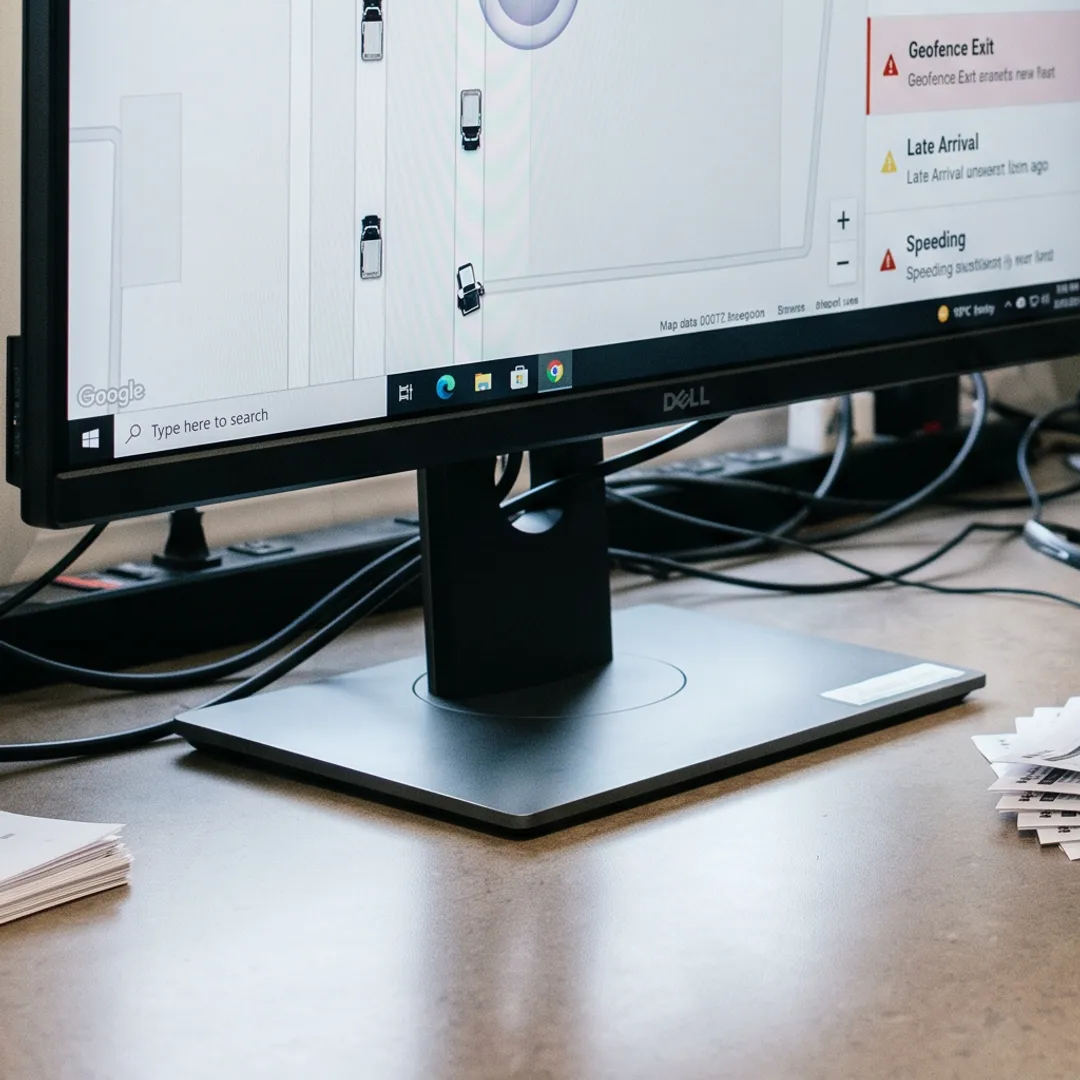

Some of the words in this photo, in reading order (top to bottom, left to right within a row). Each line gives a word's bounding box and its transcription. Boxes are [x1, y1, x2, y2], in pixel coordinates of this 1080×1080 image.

[908, 39, 968, 60] Geofence
[971, 38, 994, 57] Exit
[907, 69, 955, 88] Geofence
[907, 137, 935, 156] Late
[938, 133, 979, 154] Arrival
[906, 167, 929, 185] Late
[931, 165, 964, 182] Arrival
[907, 231, 967, 257] Speeding
[906, 260, 954, 283] Speeding
[659, 320, 678, 332] Map
[78, 379, 146, 408] Google
[663, 386, 711, 412] DELL
[151, 424, 180, 440] Type
[184, 419, 211, 434] here
[214, 416, 228, 428] to
[230, 408, 269, 425] search
